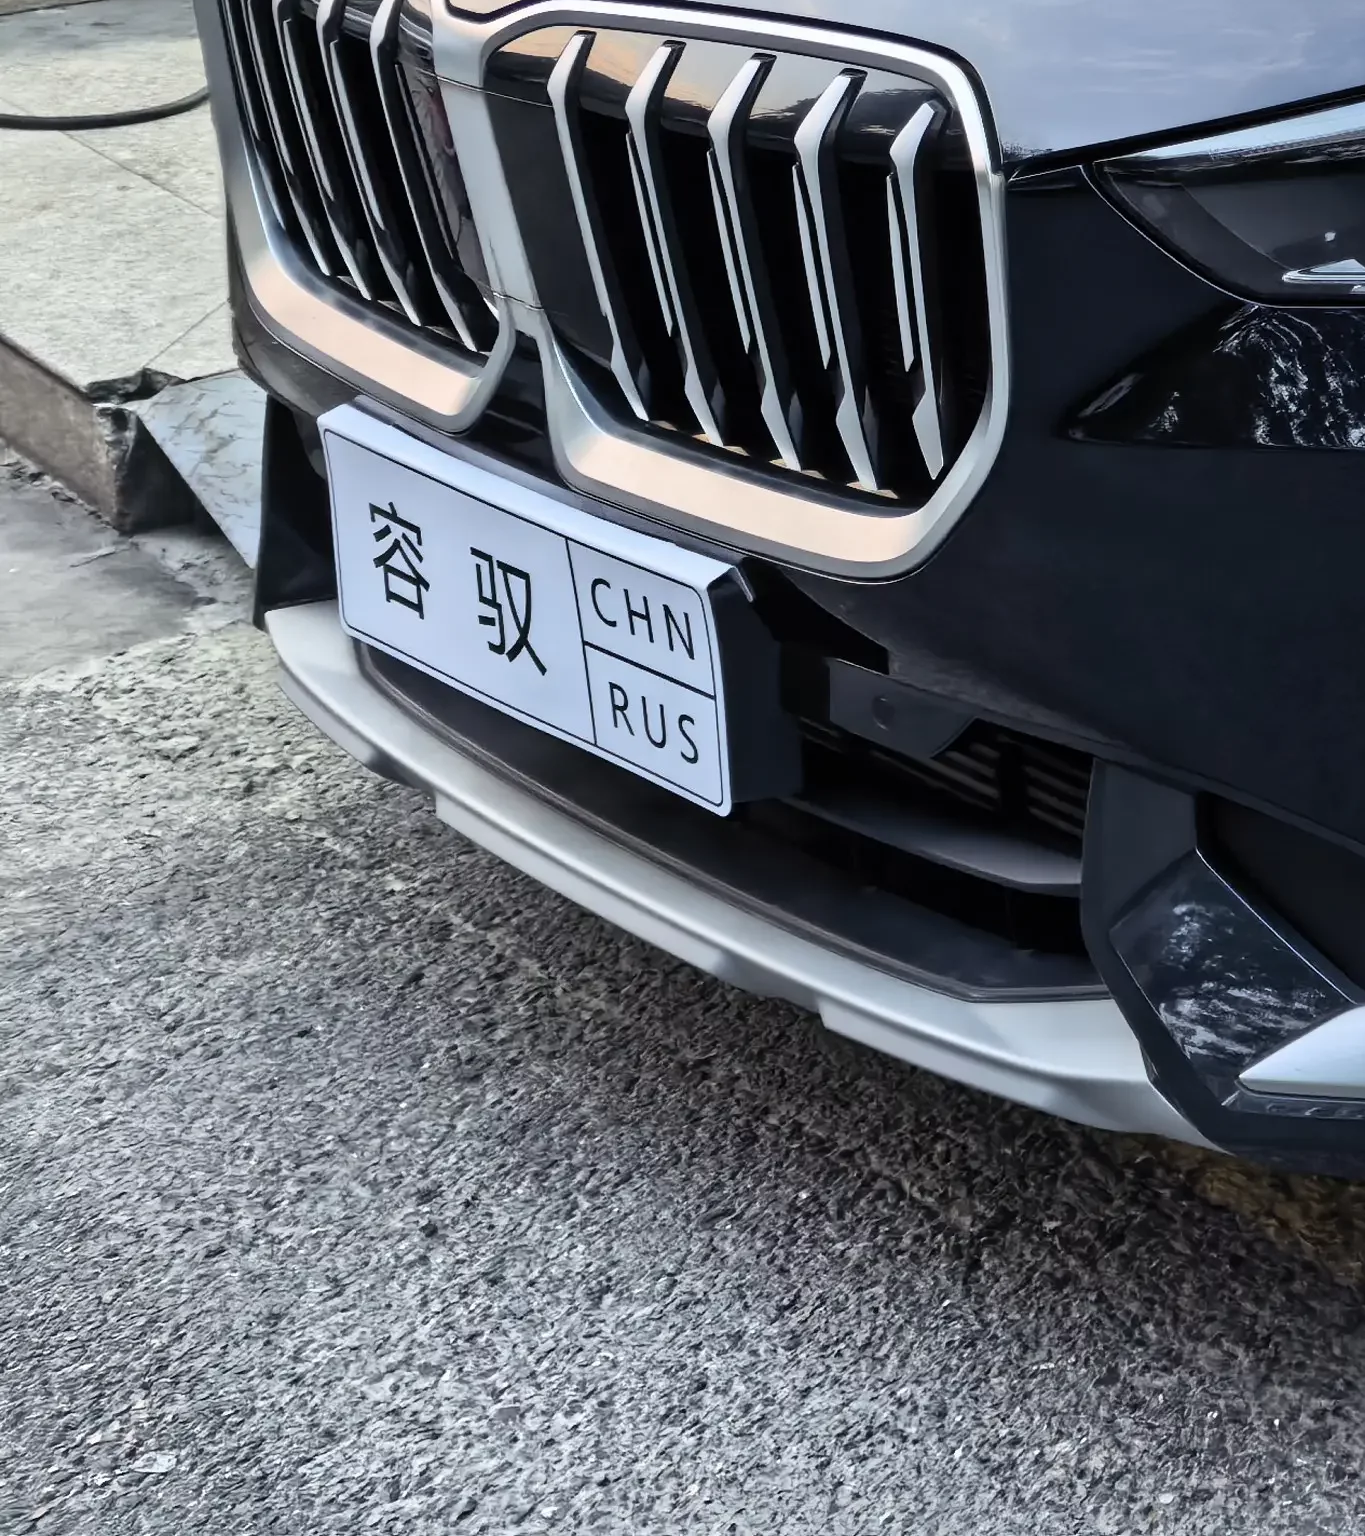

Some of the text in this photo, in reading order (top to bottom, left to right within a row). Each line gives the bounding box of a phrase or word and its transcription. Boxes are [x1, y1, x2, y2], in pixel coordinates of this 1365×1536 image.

[368, 500, 548, 677] 容驭
[590, 577, 696, 661] CHN
[607, 682, 699, 765] RUS
